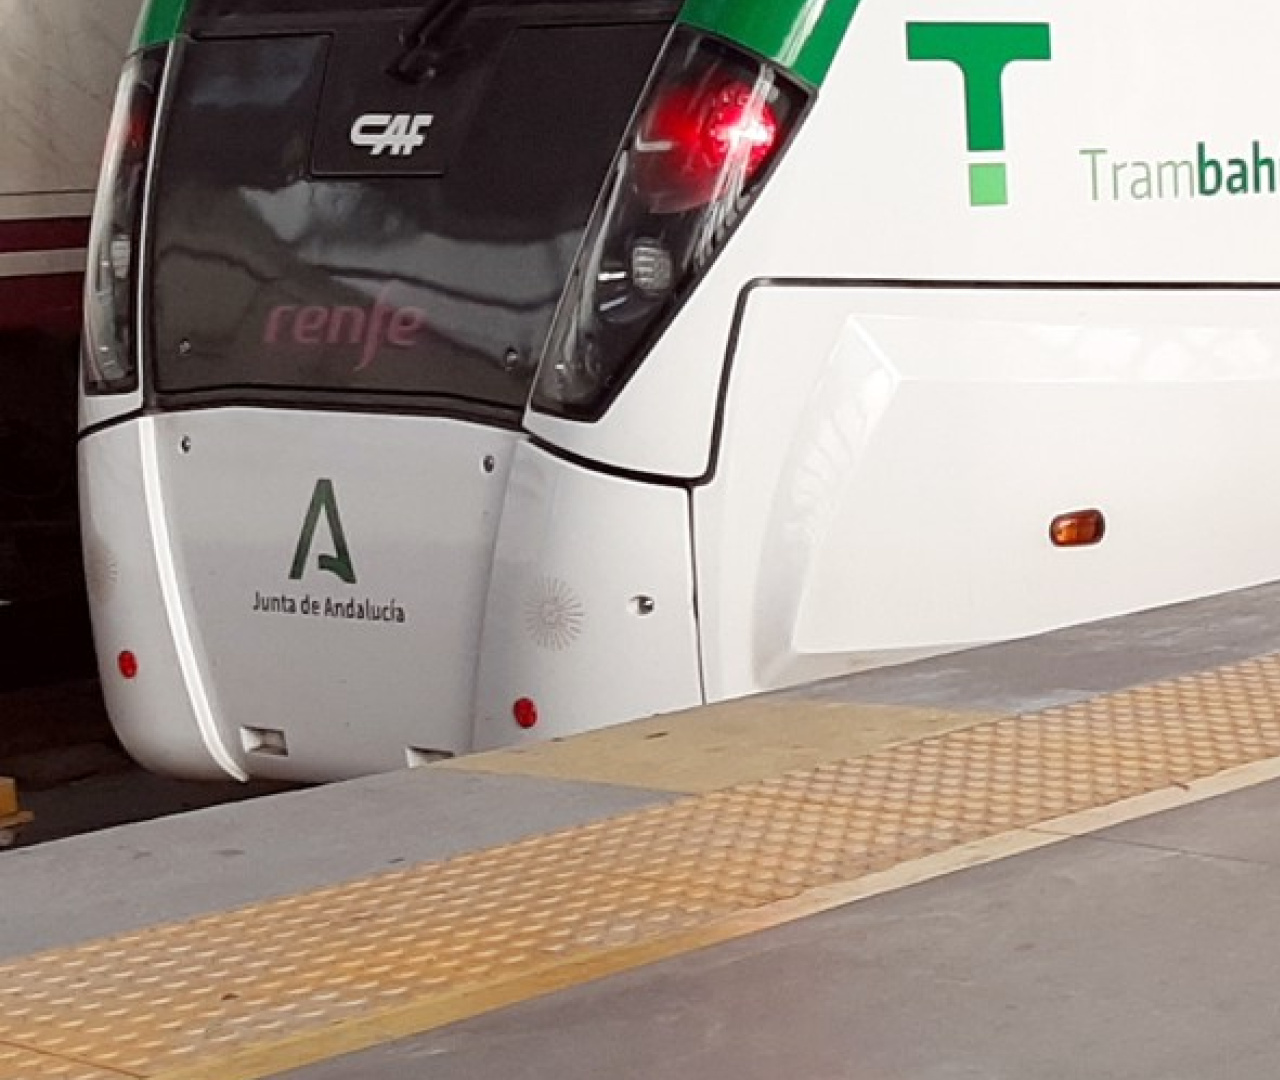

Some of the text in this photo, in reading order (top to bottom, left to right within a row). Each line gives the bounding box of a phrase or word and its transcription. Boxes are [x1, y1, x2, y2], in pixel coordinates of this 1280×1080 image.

[350, 114, 433, 155] CAF
[262, 278, 426, 372] renfe
[253, 592, 405, 623] Junta de Andalucía
